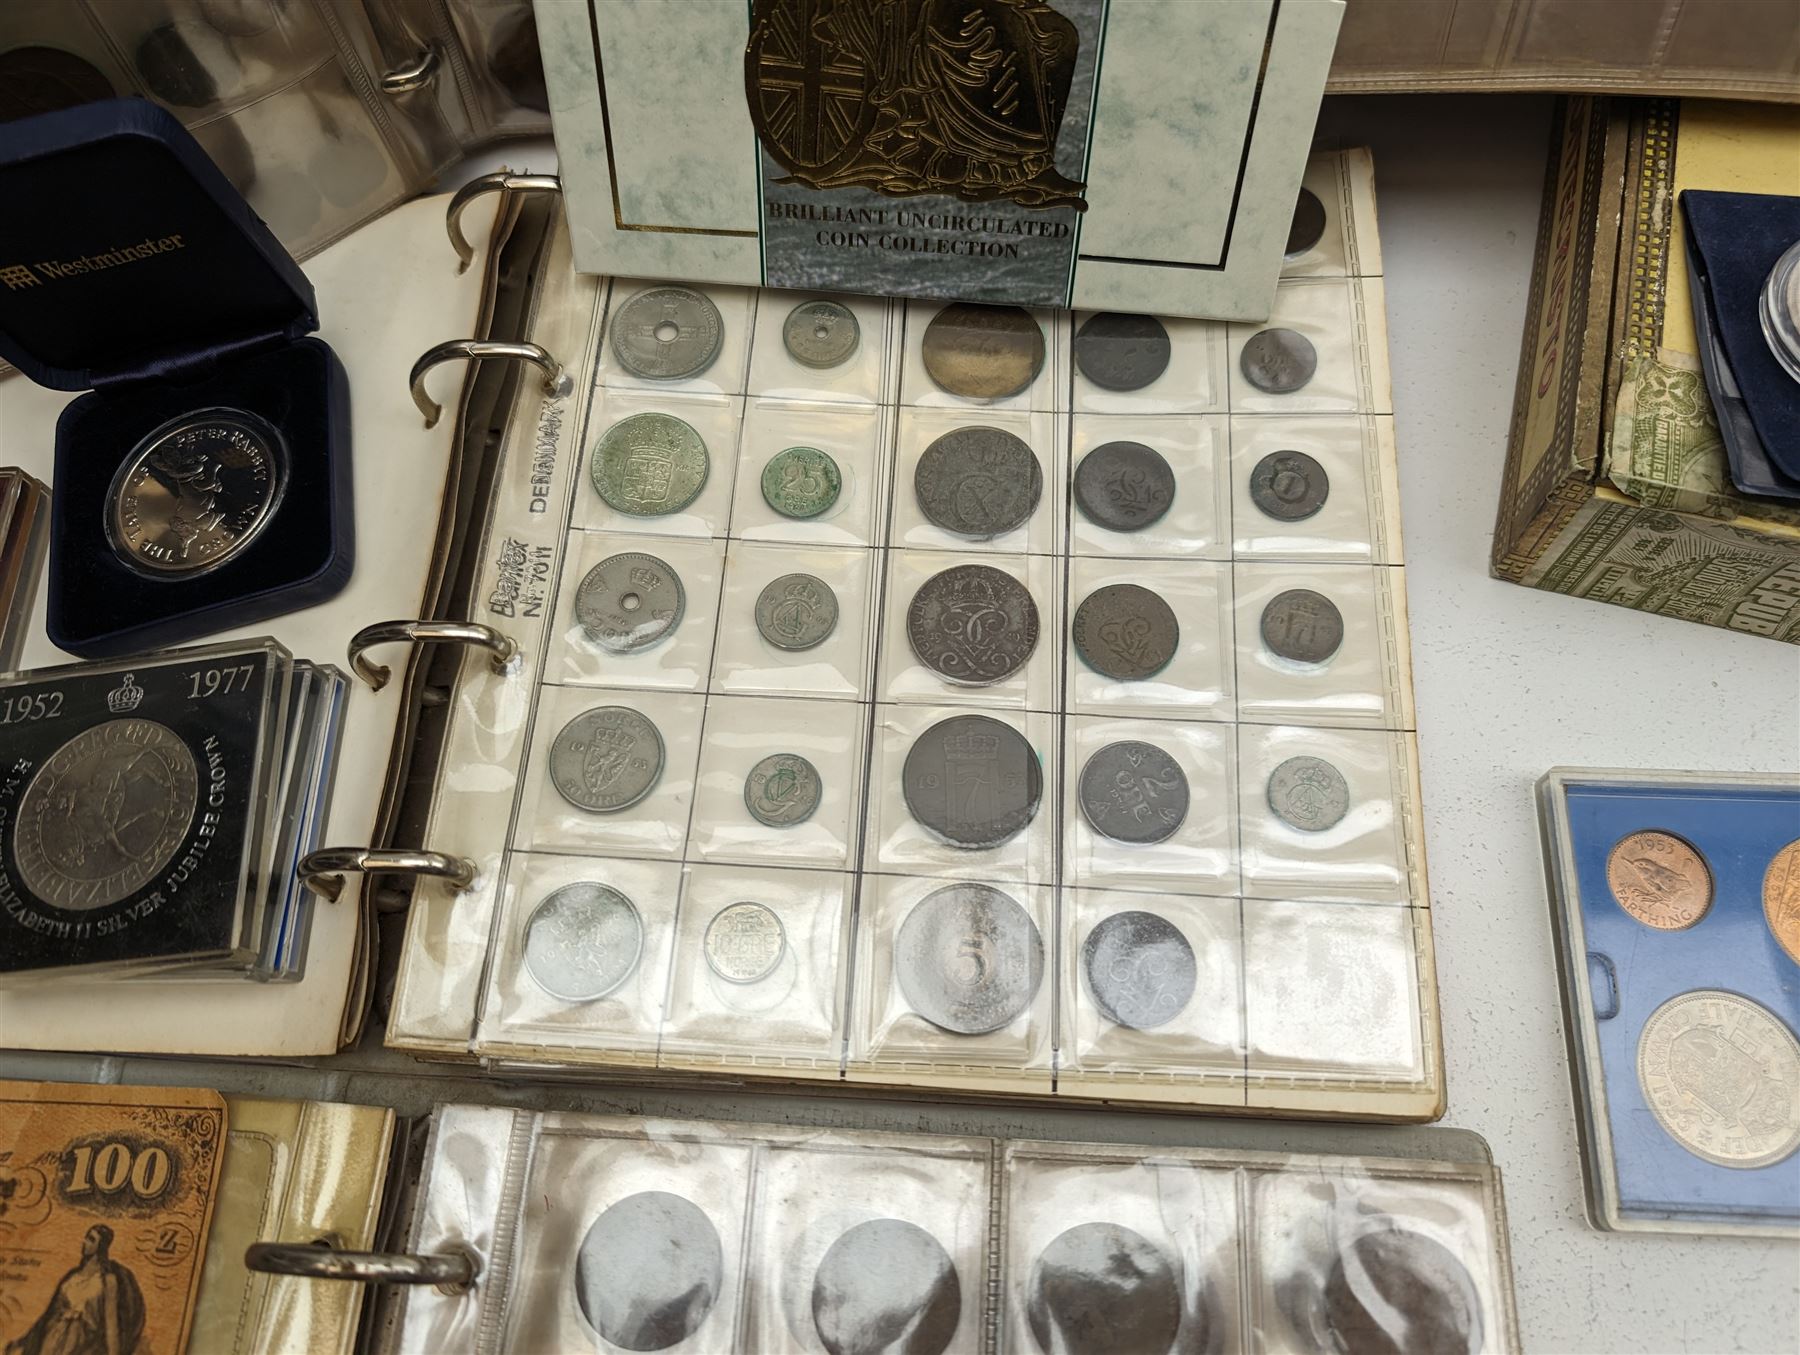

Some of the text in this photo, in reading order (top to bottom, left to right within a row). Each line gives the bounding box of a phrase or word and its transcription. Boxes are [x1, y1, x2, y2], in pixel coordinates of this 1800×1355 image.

[769, 202, 1069, 239] BRILLIANT UNCIRCULATED
[816, 230, 1020, 259] COIN COLLECTION
[34, 234, 185, 279] Westminster
[1538, 97, 1583, 398] ONTECRISTO
[176, 428, 227, 448] PETER
[230, 430, 267, 481] RABBIT
[0, 665, 255, 724] 1952 1977
[97, 891, 167, 936] SILVER
[167, 811, 220, 893] JUBILEE
[203, 734, 227, 808] CROWN
[1635, 838, 1675, 855] 1953
[1616, 888, 1693, 927] FARTHING
[952, 937, 989, 986] 5
[66, 1142, 171, 1200] 100
